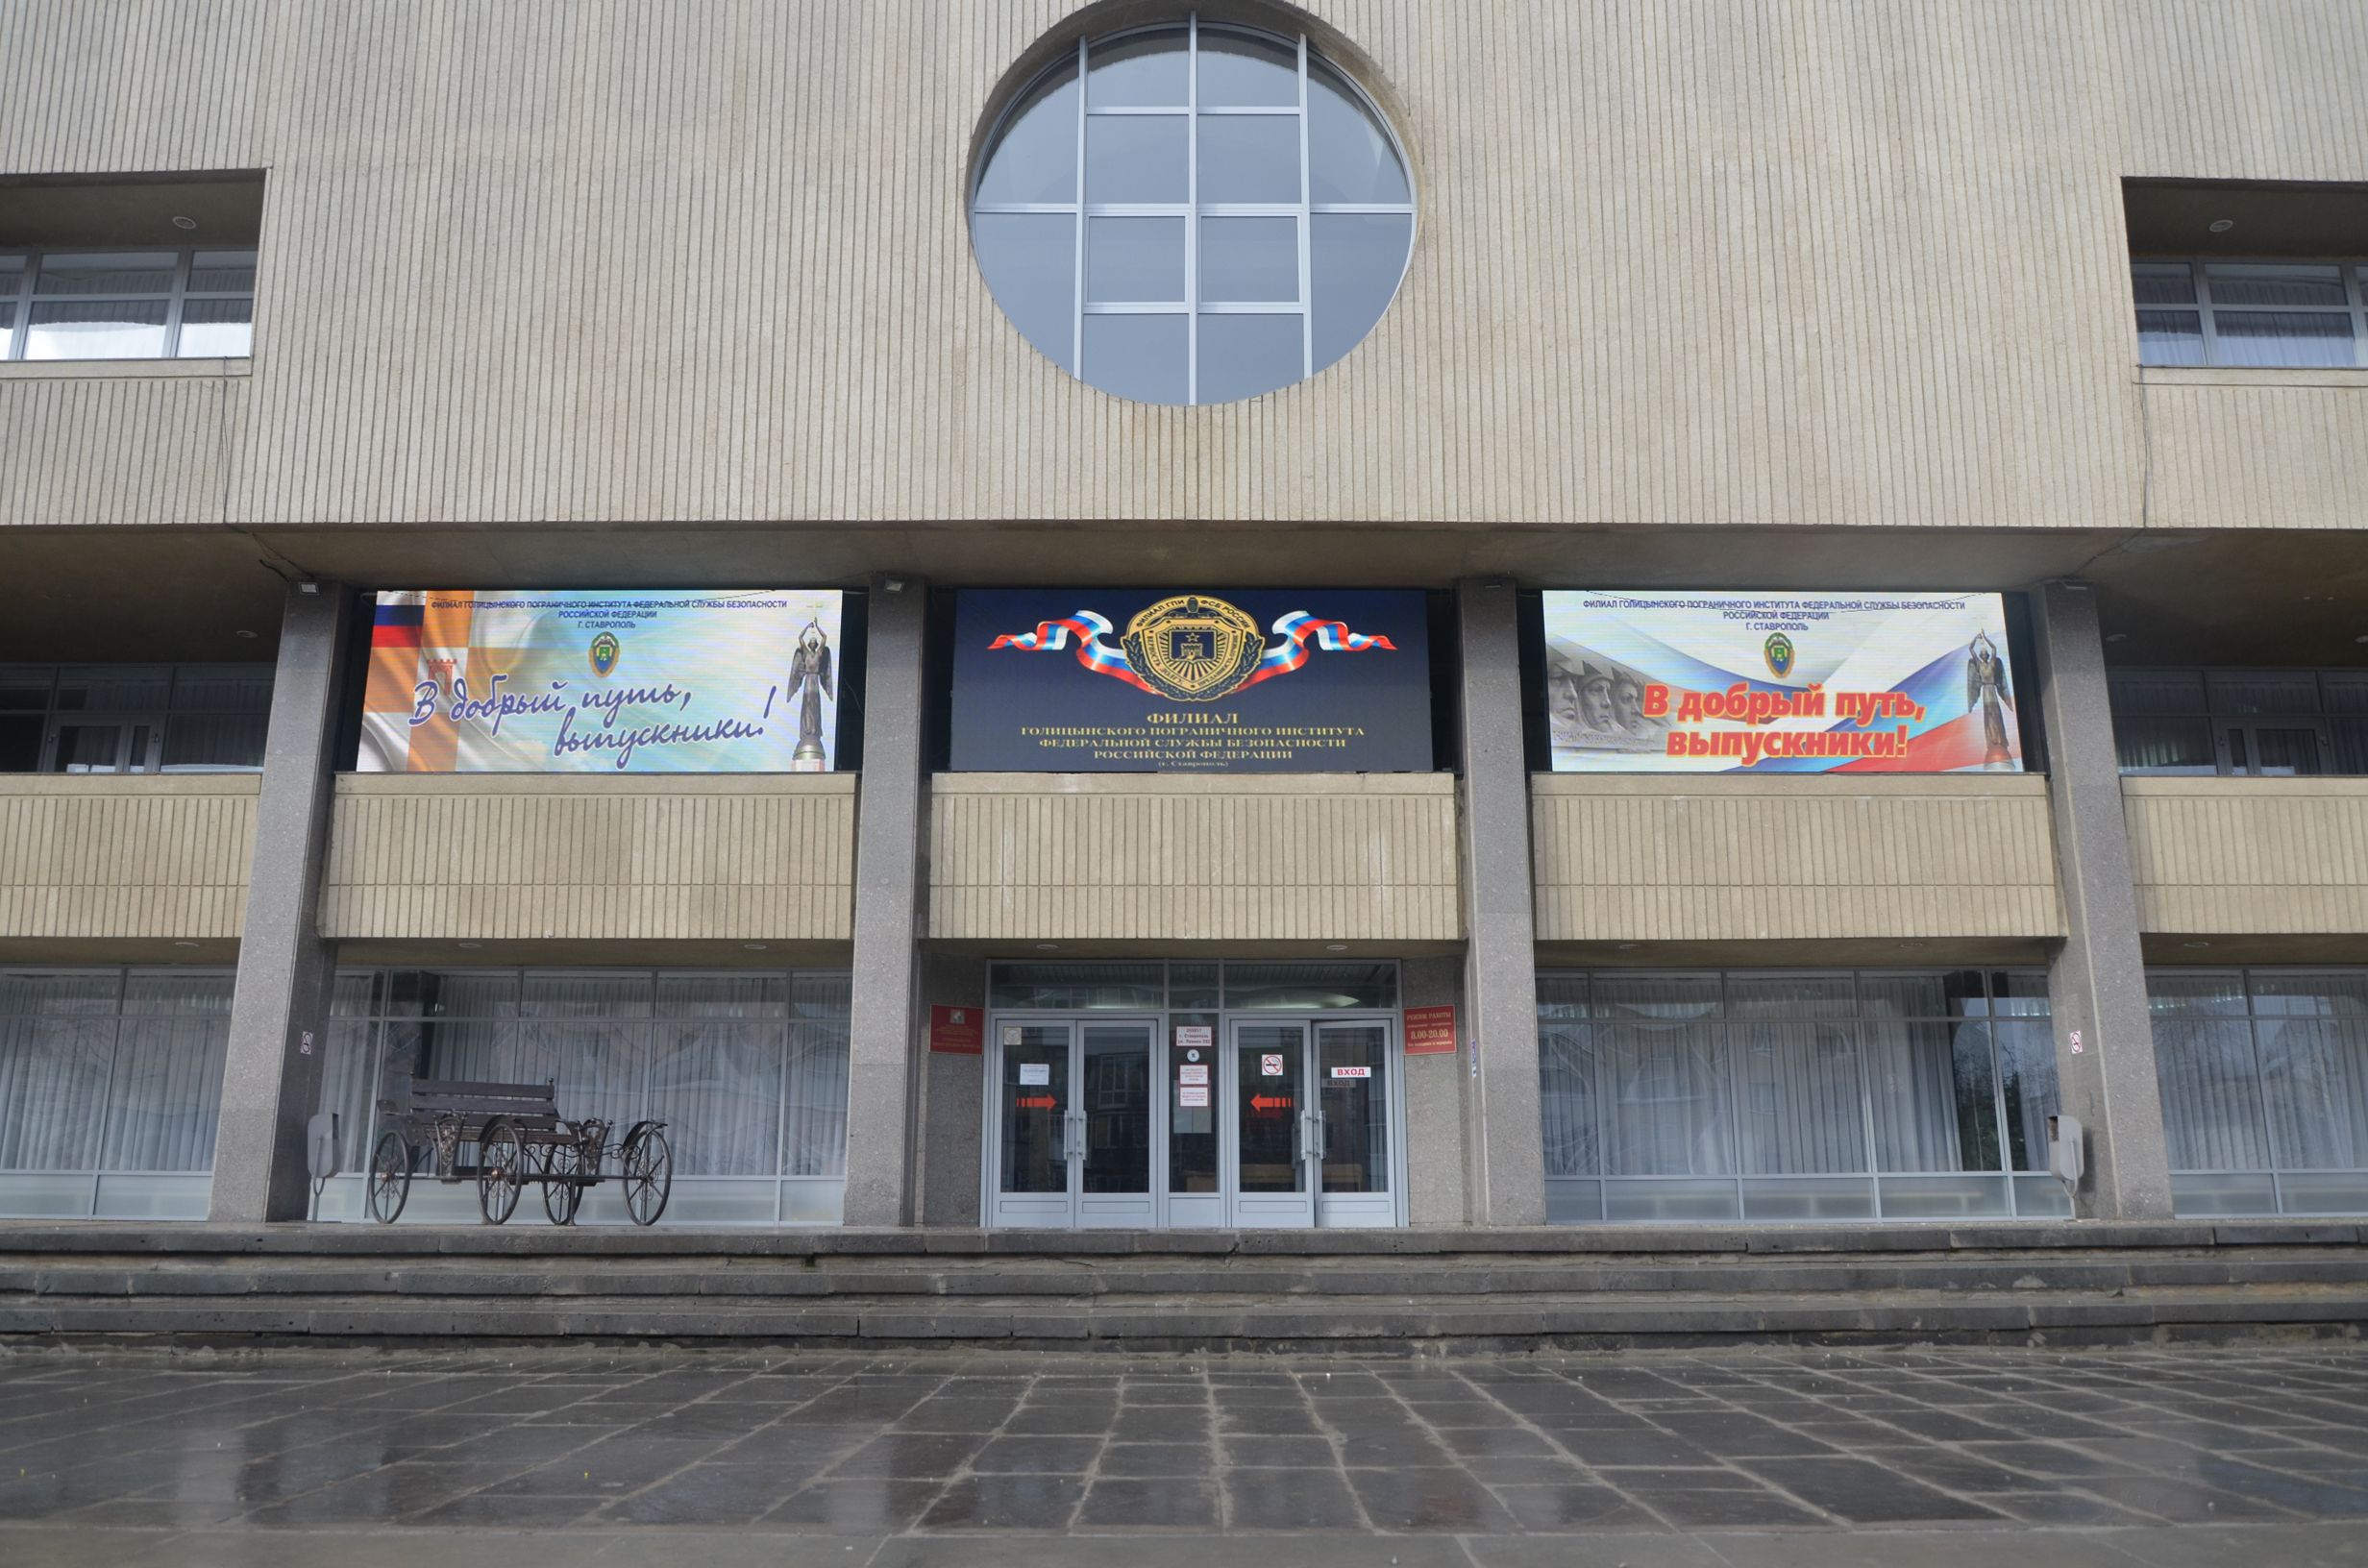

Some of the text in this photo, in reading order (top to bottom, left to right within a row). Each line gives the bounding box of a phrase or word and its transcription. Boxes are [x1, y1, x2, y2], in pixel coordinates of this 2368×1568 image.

[464, 600, 525, 609] ГОЛИЦЫНСКОГО
[633, 600, 689, 608] ФЕДЕРАЛЬНОЙ
[692, 600, 725, 608] СЛУЖБЫ
[1619, 600, 1685, 609] ГОЛИЦЫНСКОГО
[1687, 600, 1751, 609] ПОГРАНИЧНОГО
[1754, 600, 1800, 609] ИНСТИТУТА
[1803, 600, 1862, 610] ФЕДЕРАЛЬНОЙ
[1864, 600, 1899, 610] СЛУЖБЫ
[1901, 600, 1965, 610] БЕЗОПАСНОСТИ
[558, 609, 657, 619] РОССИЙСКОЙ ФЕДЕРАЦИИ
[1136, 600, 1185, 627] ФИЛИАЛ ГПИ
[1200, 600, 1251, 628] ФСБ РОССИИ
[1723, 610, 1829, 620] РОССИЙСКОЙ ФЕДЕРАЦИИ
[408, 674, 692, 737] В добрый путь,
[1642, 681, 1927, 725] В добрый путь,
[1147, 713, 1239, 724] ФИЛИАЛ
[555, 685, 777, 769] выпускники!
[1021, 726, 1365, 736] ГОЛИЦЫНСКОГО ПОГРАНИЧНОГО ИНСТИТУТА
[1039, 738, 1346, 748] ФЕДЕРАЛЬНОЙ СЛУЖБЫ БЕЗОПАСНОСТИ
[1665, 724, 1909, 767] выпускники!
[1094, 749, 1293, 760] РОССИЙСКОЙ ФЕДЕРАЦИИ
